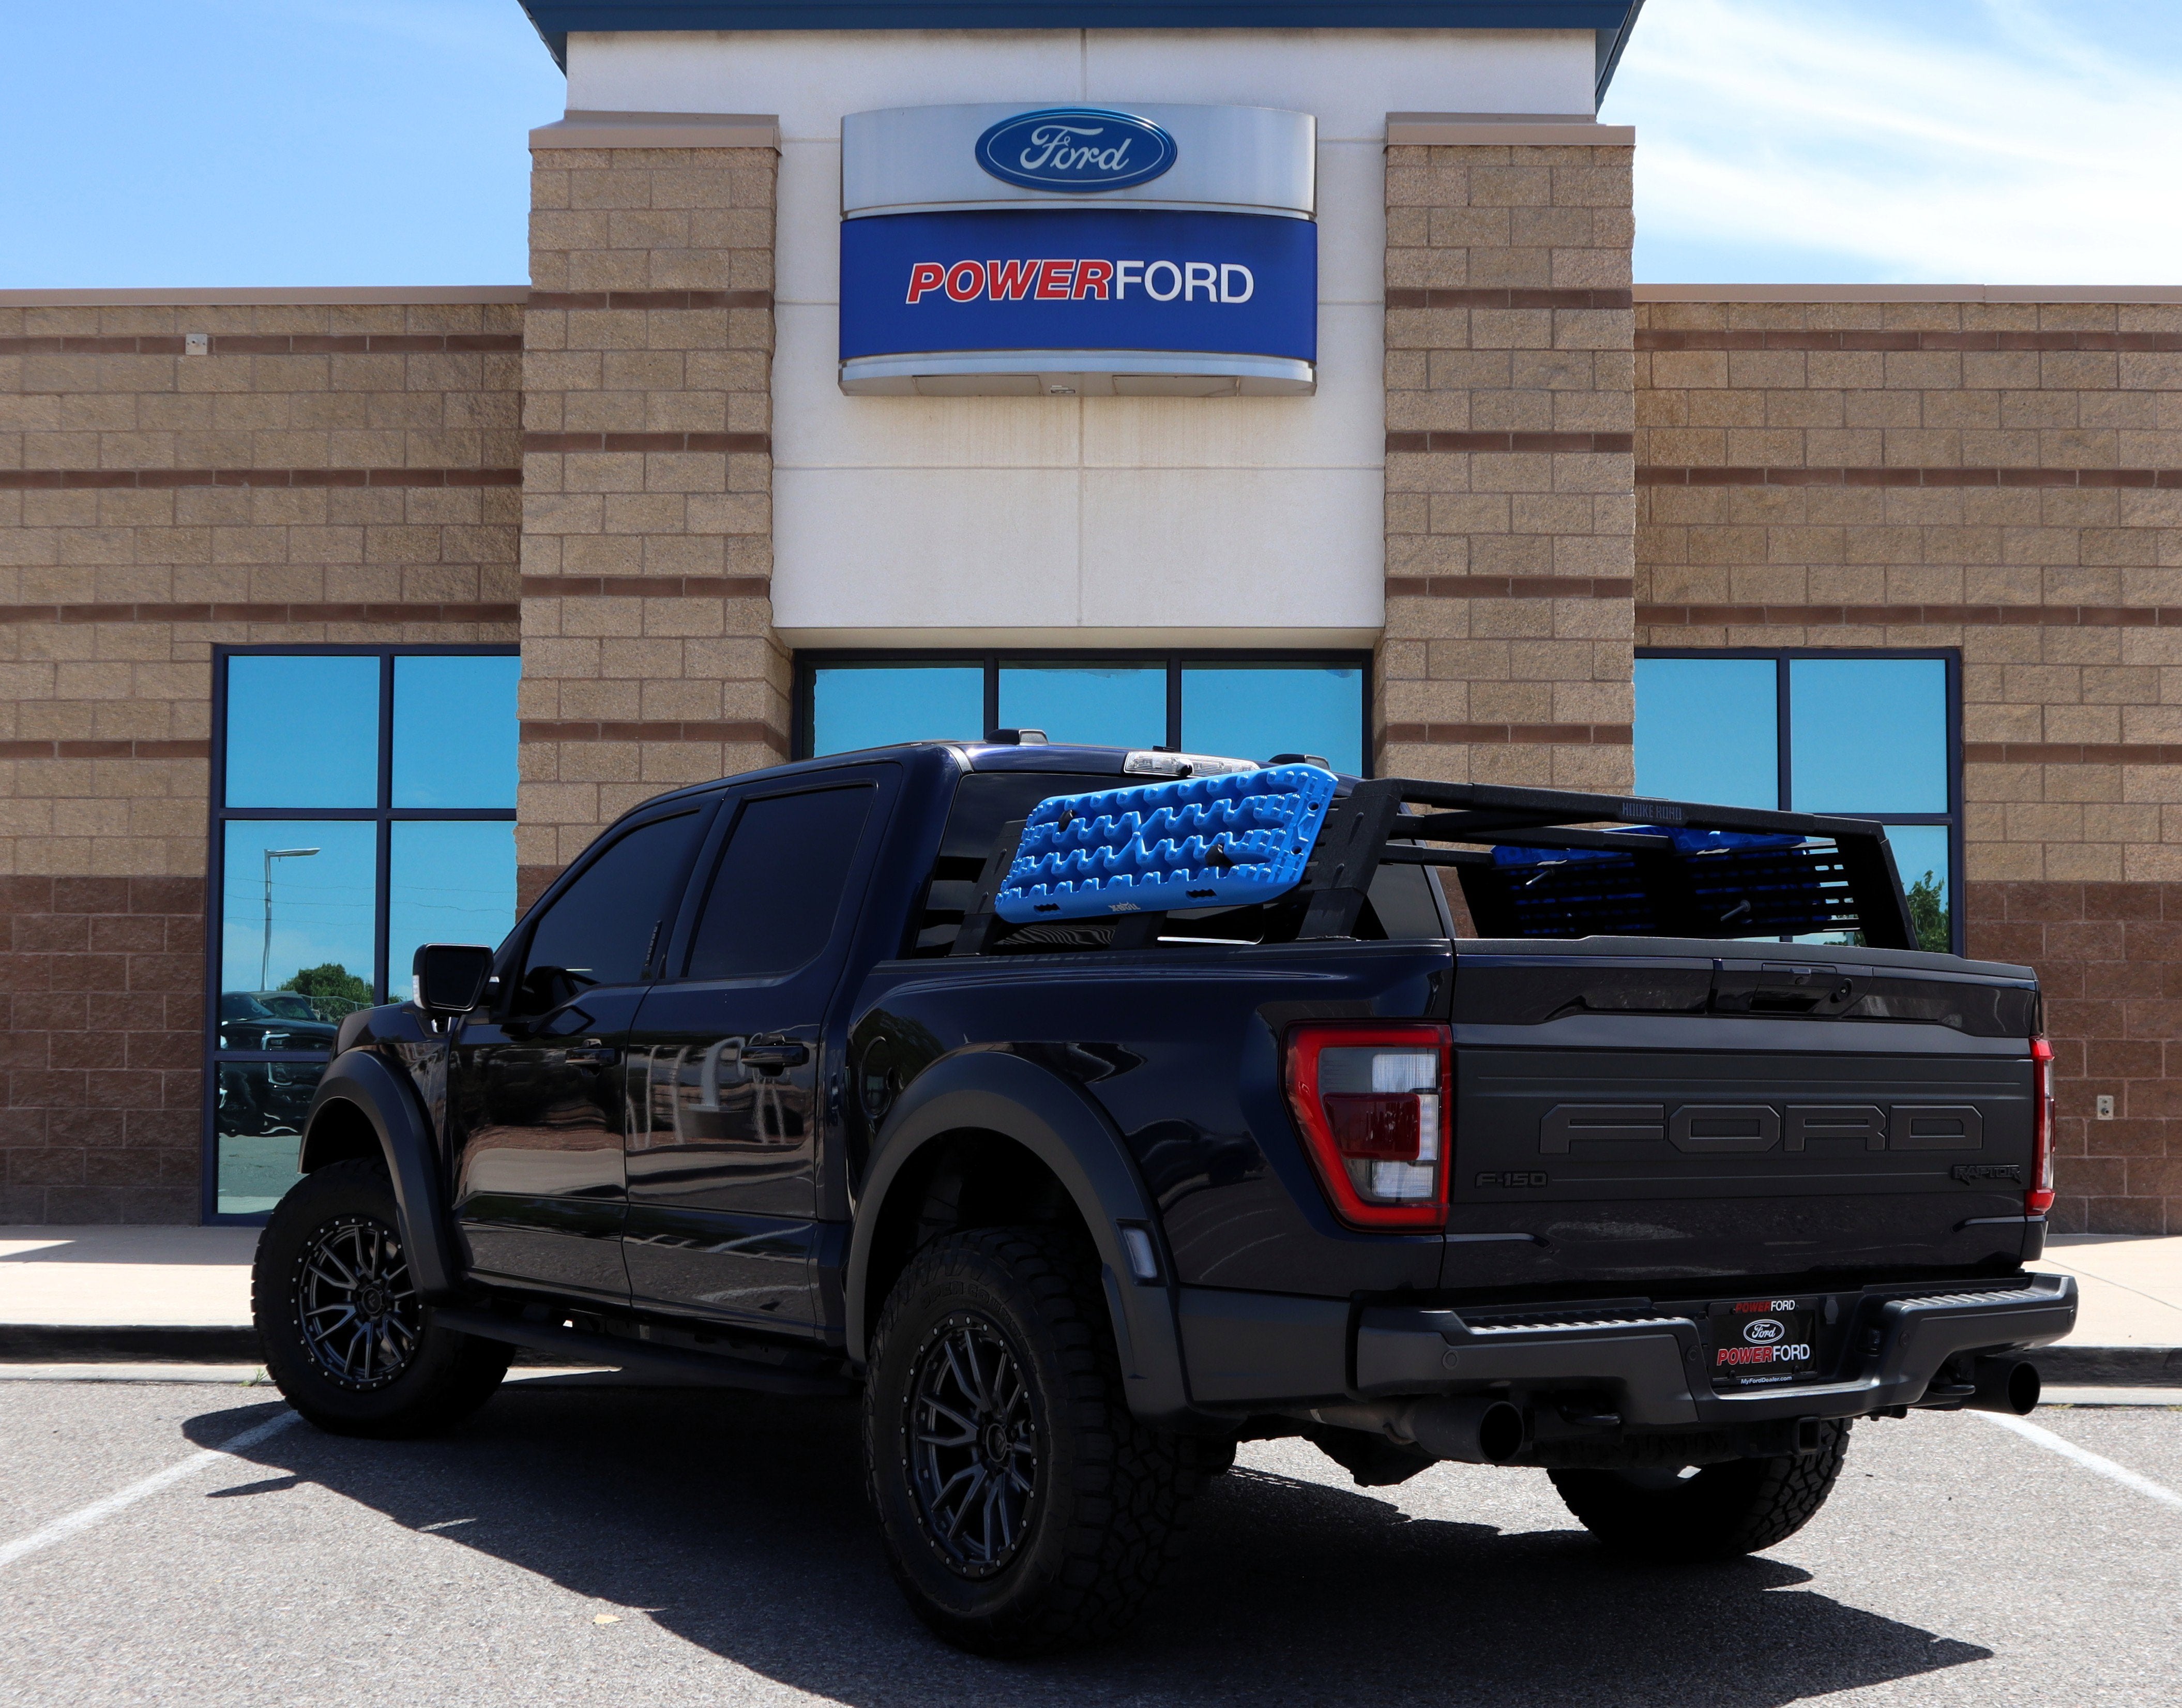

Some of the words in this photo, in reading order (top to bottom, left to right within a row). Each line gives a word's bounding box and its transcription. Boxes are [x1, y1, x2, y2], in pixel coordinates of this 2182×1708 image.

[1019, 124, 1130, 171] Ford
[1539, 1103, 1984, 1155] FORD
[1475, 1171, 1548, 1189] F-150
[1951, 1163, 2023, 1186] RAPTOR
[1751, 1323, 1777, 1339] Ford
[1740, 1376, 1792, 1384] MyFordDealer.com
